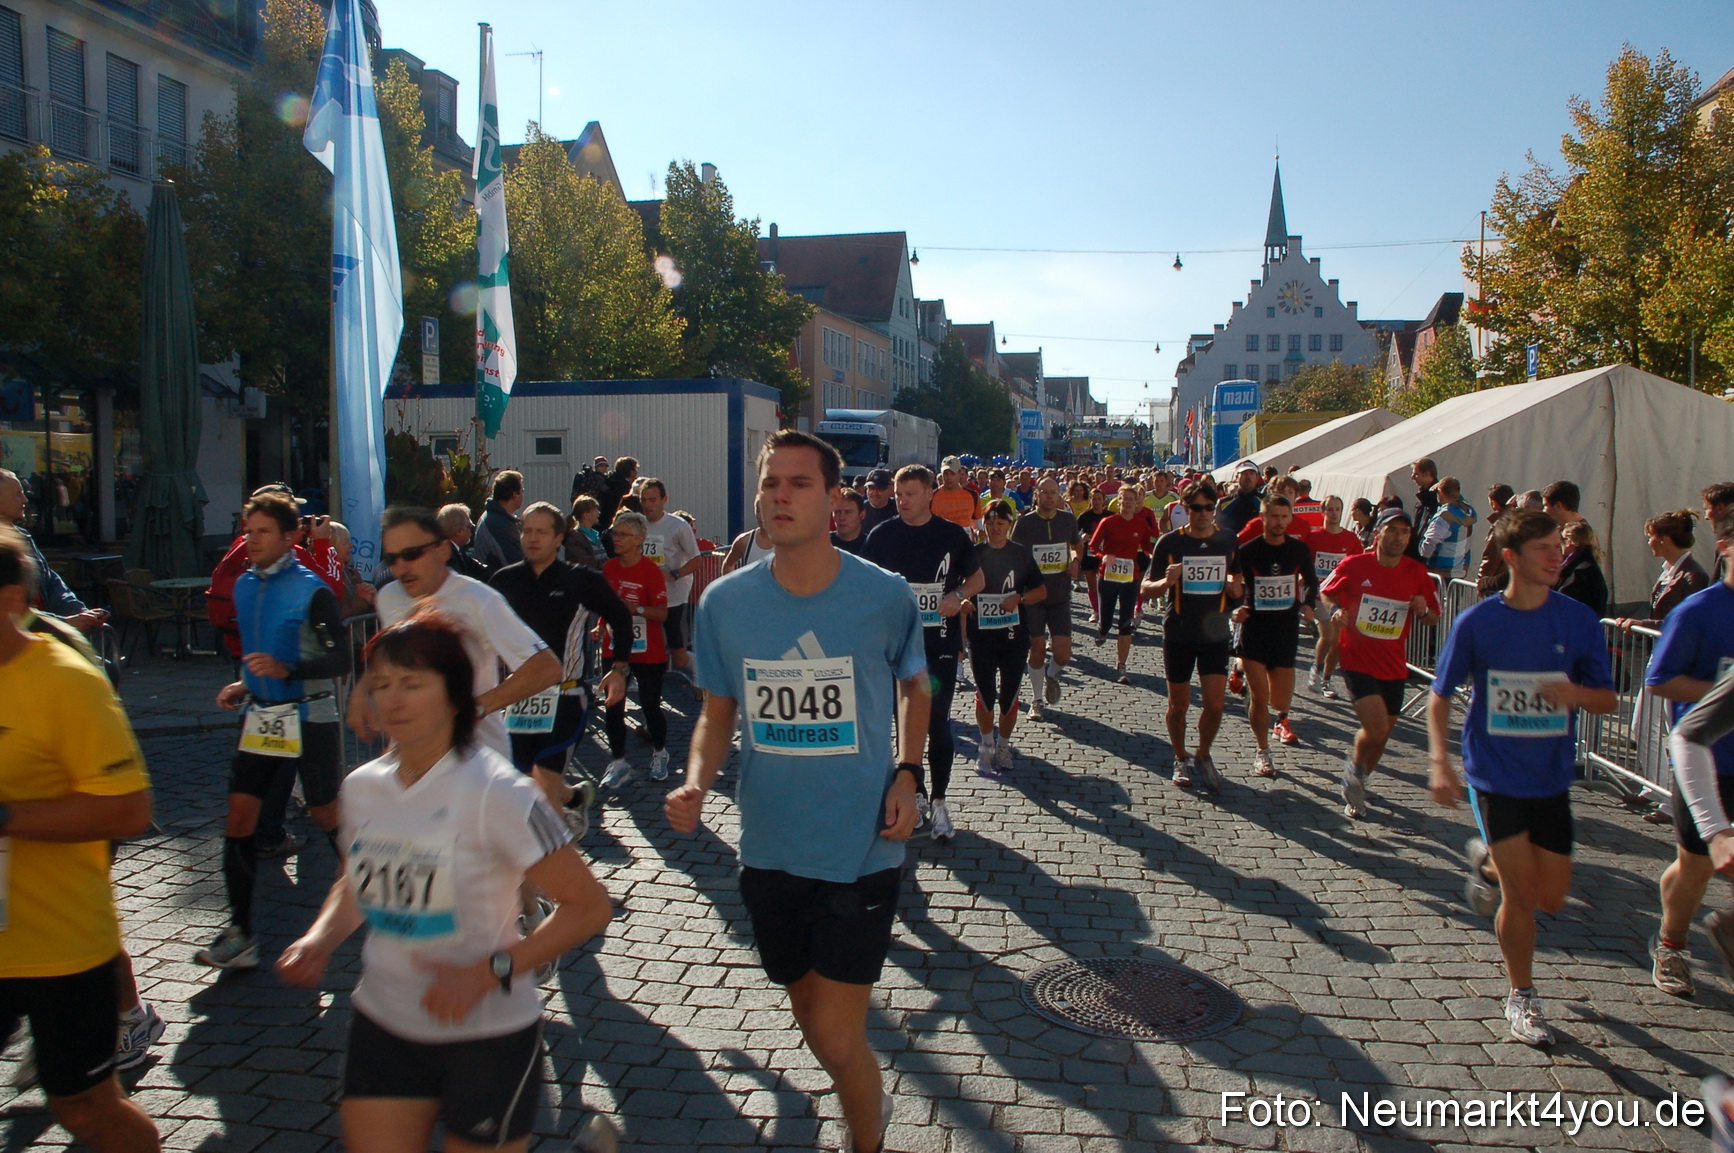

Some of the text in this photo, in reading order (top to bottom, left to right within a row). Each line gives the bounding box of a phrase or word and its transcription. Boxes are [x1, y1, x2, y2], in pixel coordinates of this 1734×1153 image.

[425, 321, 436, 348] P
[1529, 345, 1536, 369] P
[1223, 388, 1255, 405] maxi
[1023, 415, 1038, 426] axi
[1040, 551, 1061, 563] 462
[1318, 558, 1341, 570] 319
[356, 562, 373, 573] EN
[1111, 563, 1128, 574] 915
[1187, 566, 1221, 581] 3571
[1259, 584, 1291, 598] 3314
[917, 594, 938, 611] 98
[982, 603, 1013, 617] 228
[1368, 606, 1398, 625] 344
[1365, 622, 1395, 634] Roland
[511, 697, 551, 715] 3255
[756, 684, 843, 721] 2048
[765, 723, 840, 743] Andreas
